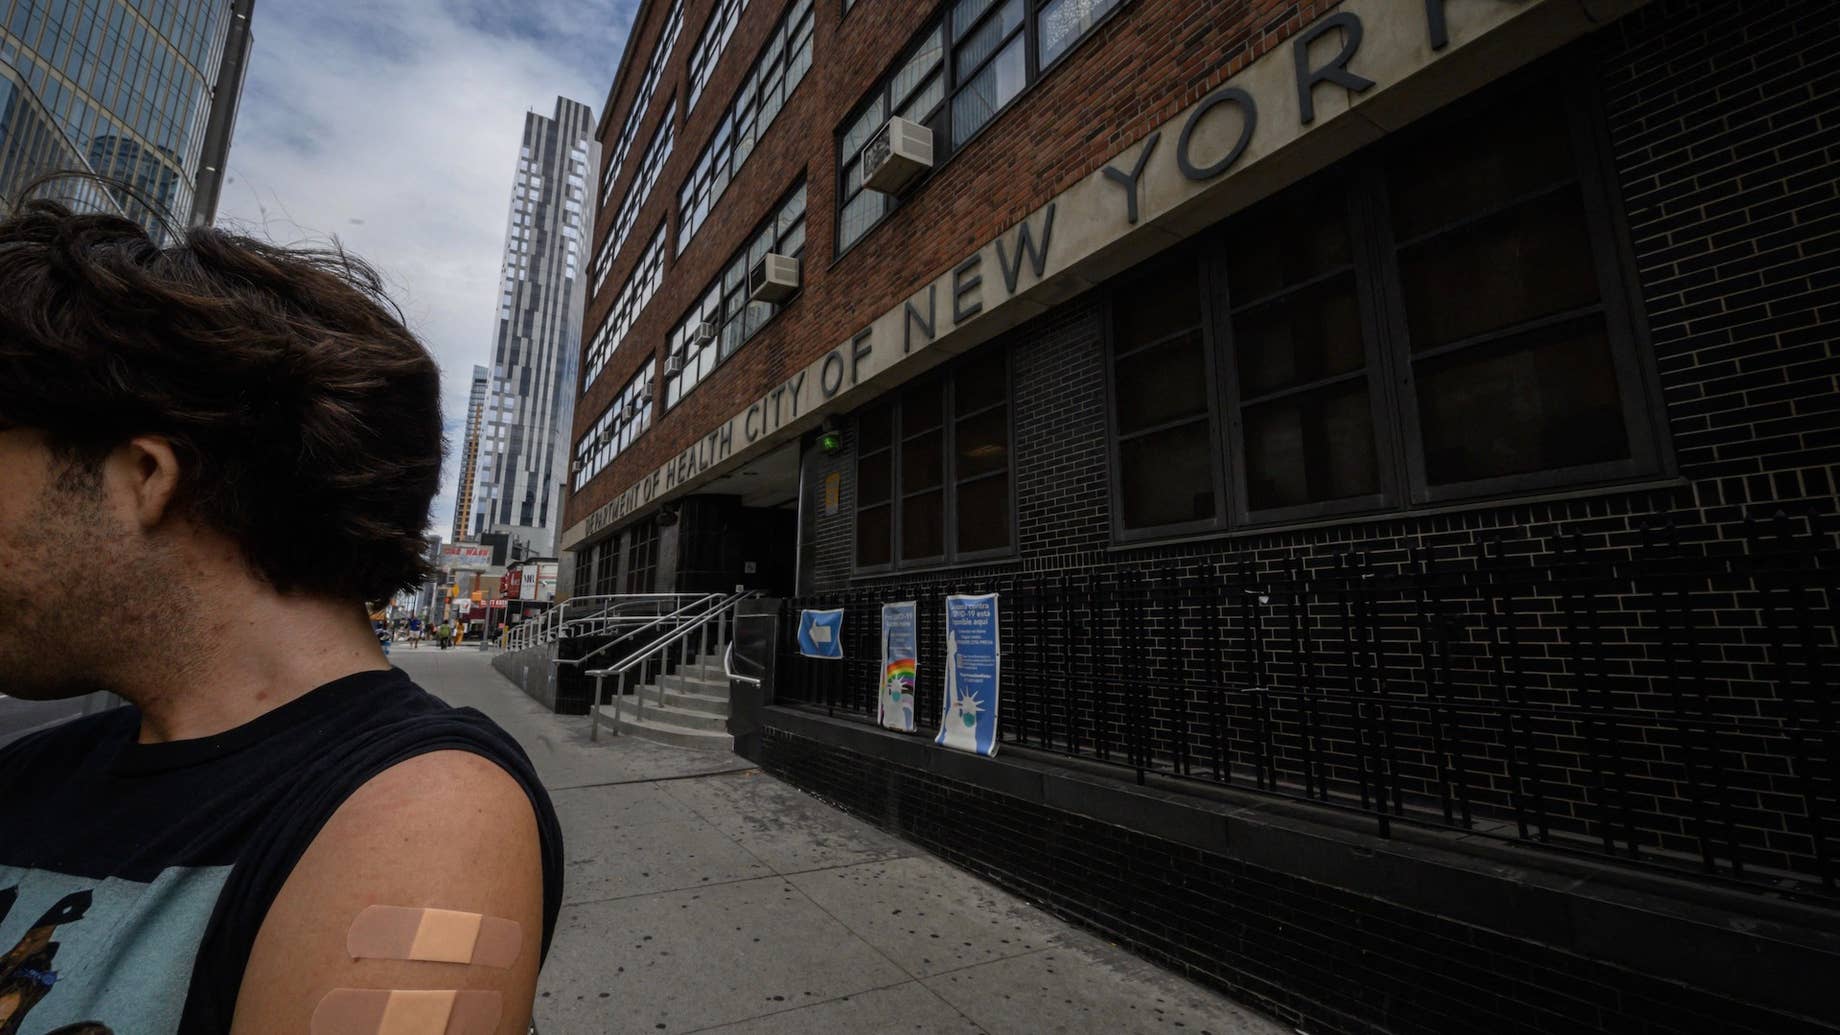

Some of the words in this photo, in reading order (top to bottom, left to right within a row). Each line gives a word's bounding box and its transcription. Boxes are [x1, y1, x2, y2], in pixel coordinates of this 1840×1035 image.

[643, 469, 661, 502] OF
[666, 419, 735, 490] HEALTH
[744, 370, 806, 442] CITY
[820, 327, 873, 398] OF
[903, 203, 1057, 354] NEW
